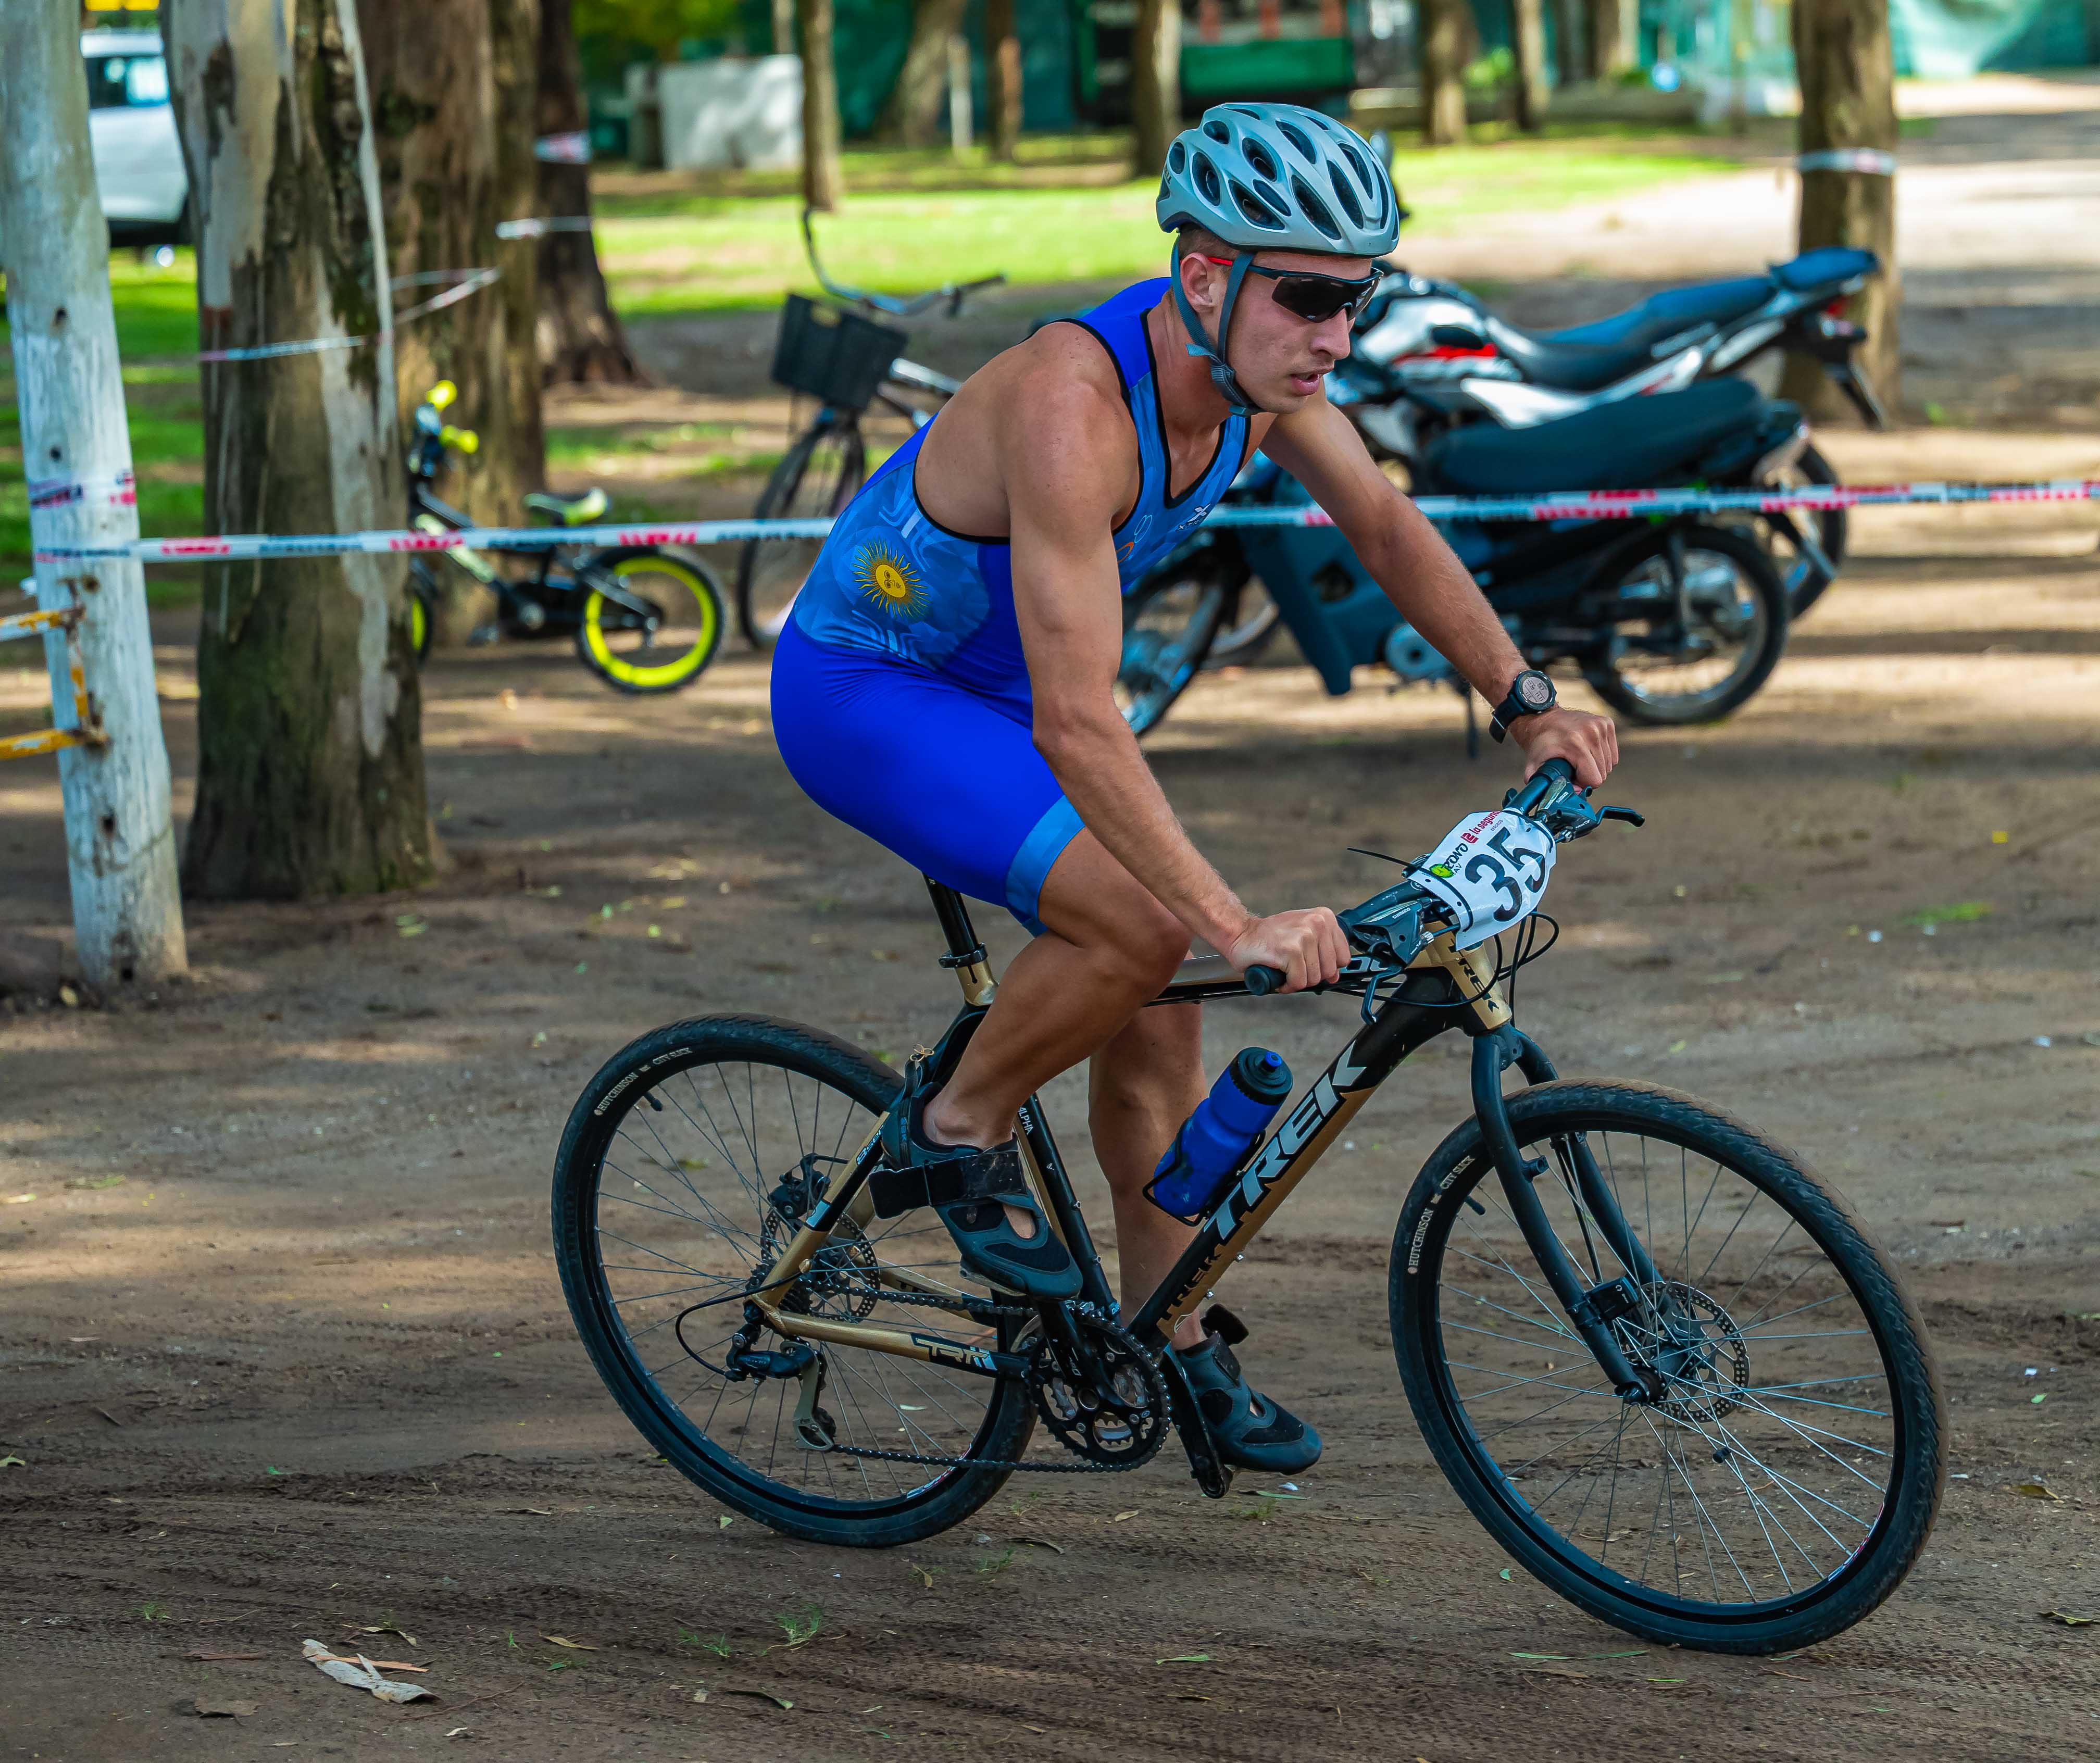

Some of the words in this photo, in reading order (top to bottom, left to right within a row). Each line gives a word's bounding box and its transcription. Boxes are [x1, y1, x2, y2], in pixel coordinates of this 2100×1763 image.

[1392, 907, 1411, 920] SHIMANO
[1465, 826, 1546, 922] 35
[596, 1071, 639, 1111] HUTCHINSON
[652, 1054, 671, 1065] CITY
[669, 1047, 693, 1058] SLICK
[1018, 1107, 1034, 1135] ALPHA
[1203, 1040, 1367, 1240] TREK
[1408, 1208, 1434, 1267] HUTCHINSON
[1440, 1172, 1457, 1190] CITY
[1453, 1155, 1476, 1174] SLICK
